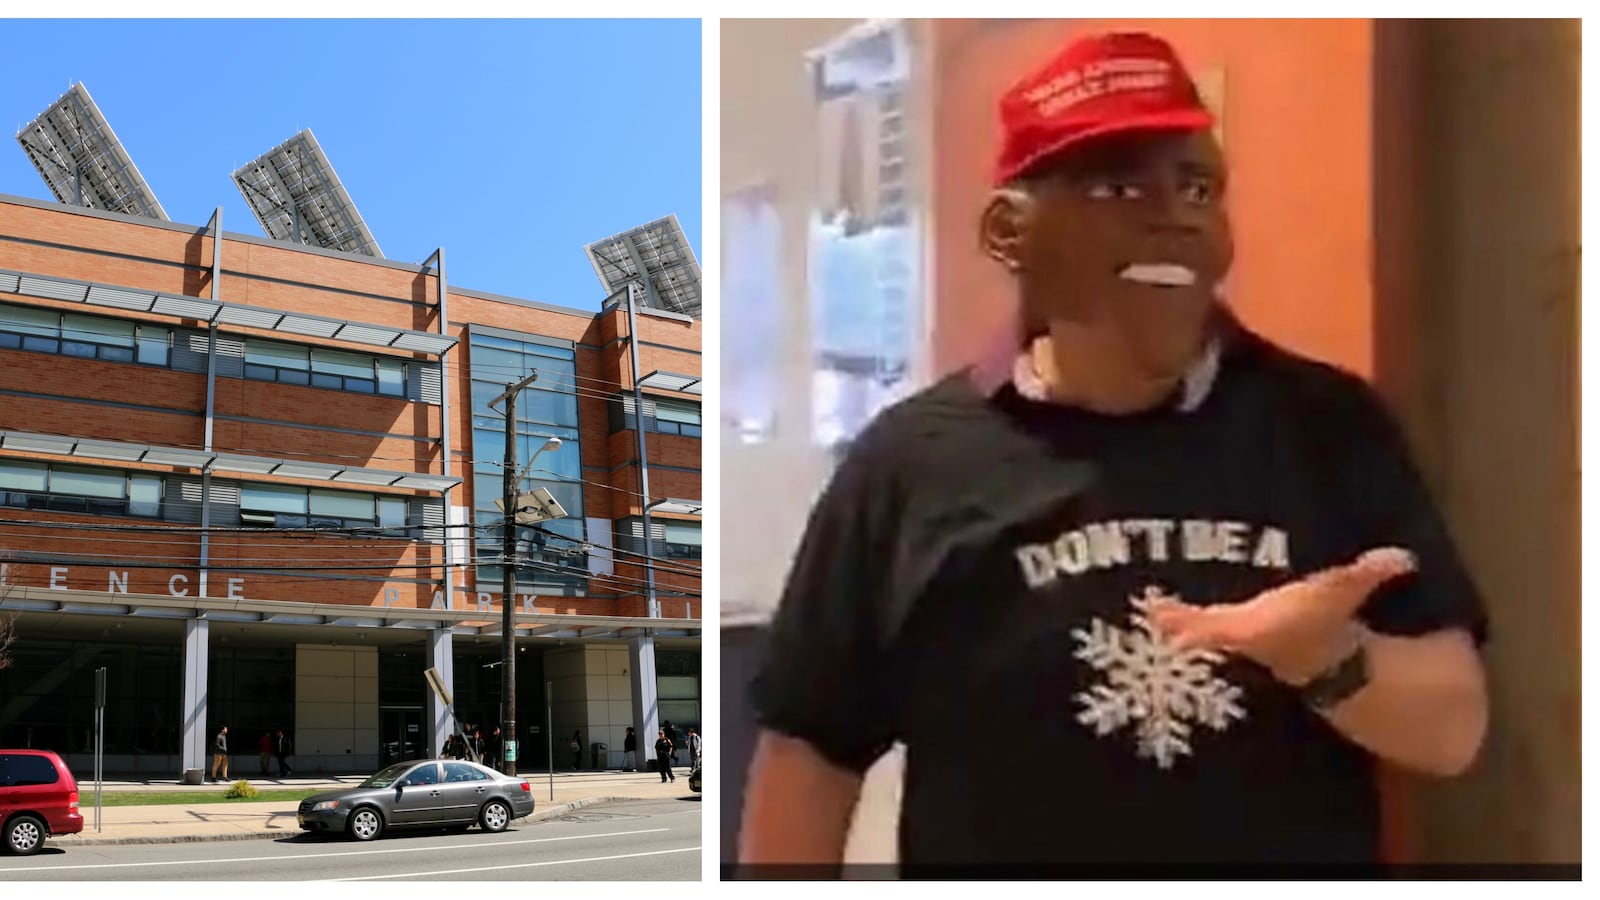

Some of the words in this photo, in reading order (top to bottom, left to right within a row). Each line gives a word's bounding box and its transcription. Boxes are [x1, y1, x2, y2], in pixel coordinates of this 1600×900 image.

[1016, 519, 1175, 588] DON'T
[1180, 519, 1250, 563] BE
[1252, 526, 1290, 568] A
[383, 587, 538, 615] PARK
